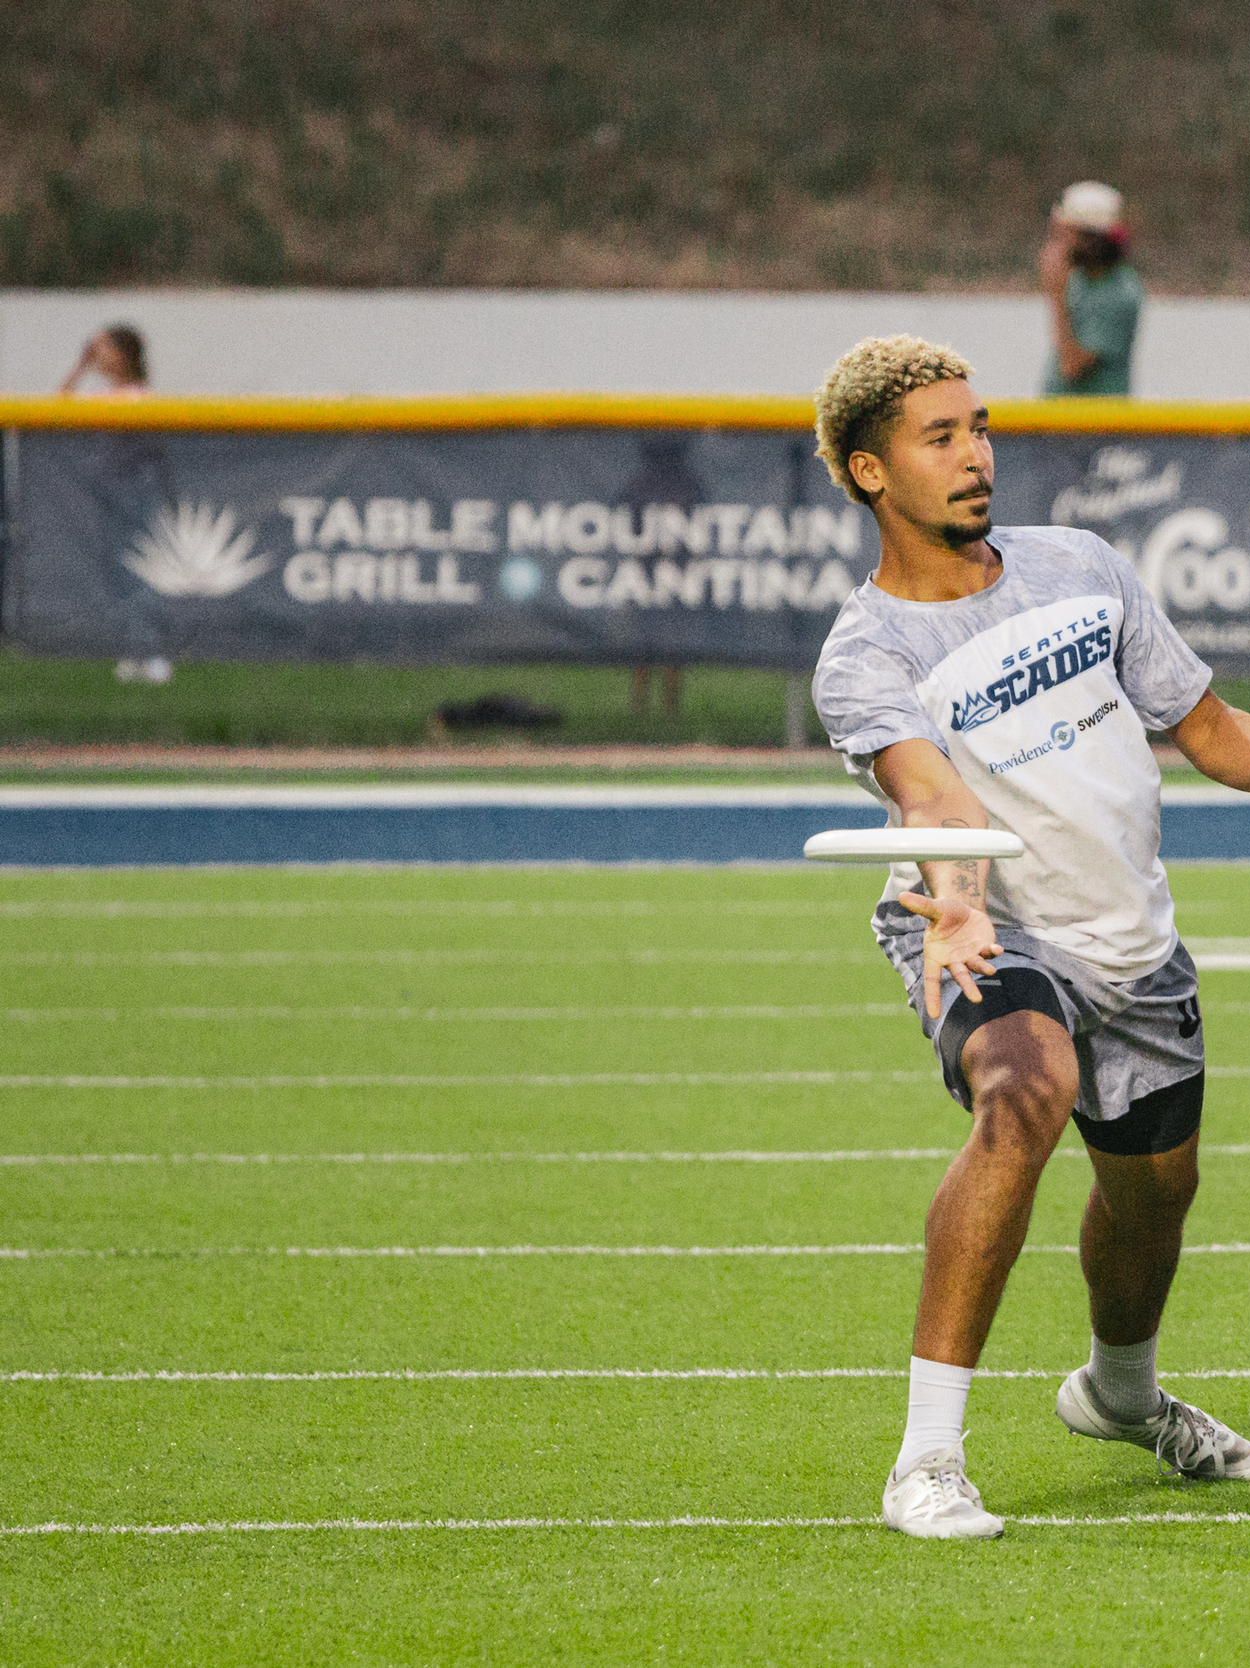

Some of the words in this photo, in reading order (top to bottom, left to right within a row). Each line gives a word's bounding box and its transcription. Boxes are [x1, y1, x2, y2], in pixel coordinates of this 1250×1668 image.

[279, 496, 497, 551] TABLE
[507, 500, 861, 556] MOUNTAIN
[283, 551, 481, 603] GRILL
[557, 555, 854, 608] CANTINA
[1002, 609, 1108, 670] SEATTLE
[989, 740, 1053, 774] Providence
[1077, 700, 1119, 731] SWEDISH
